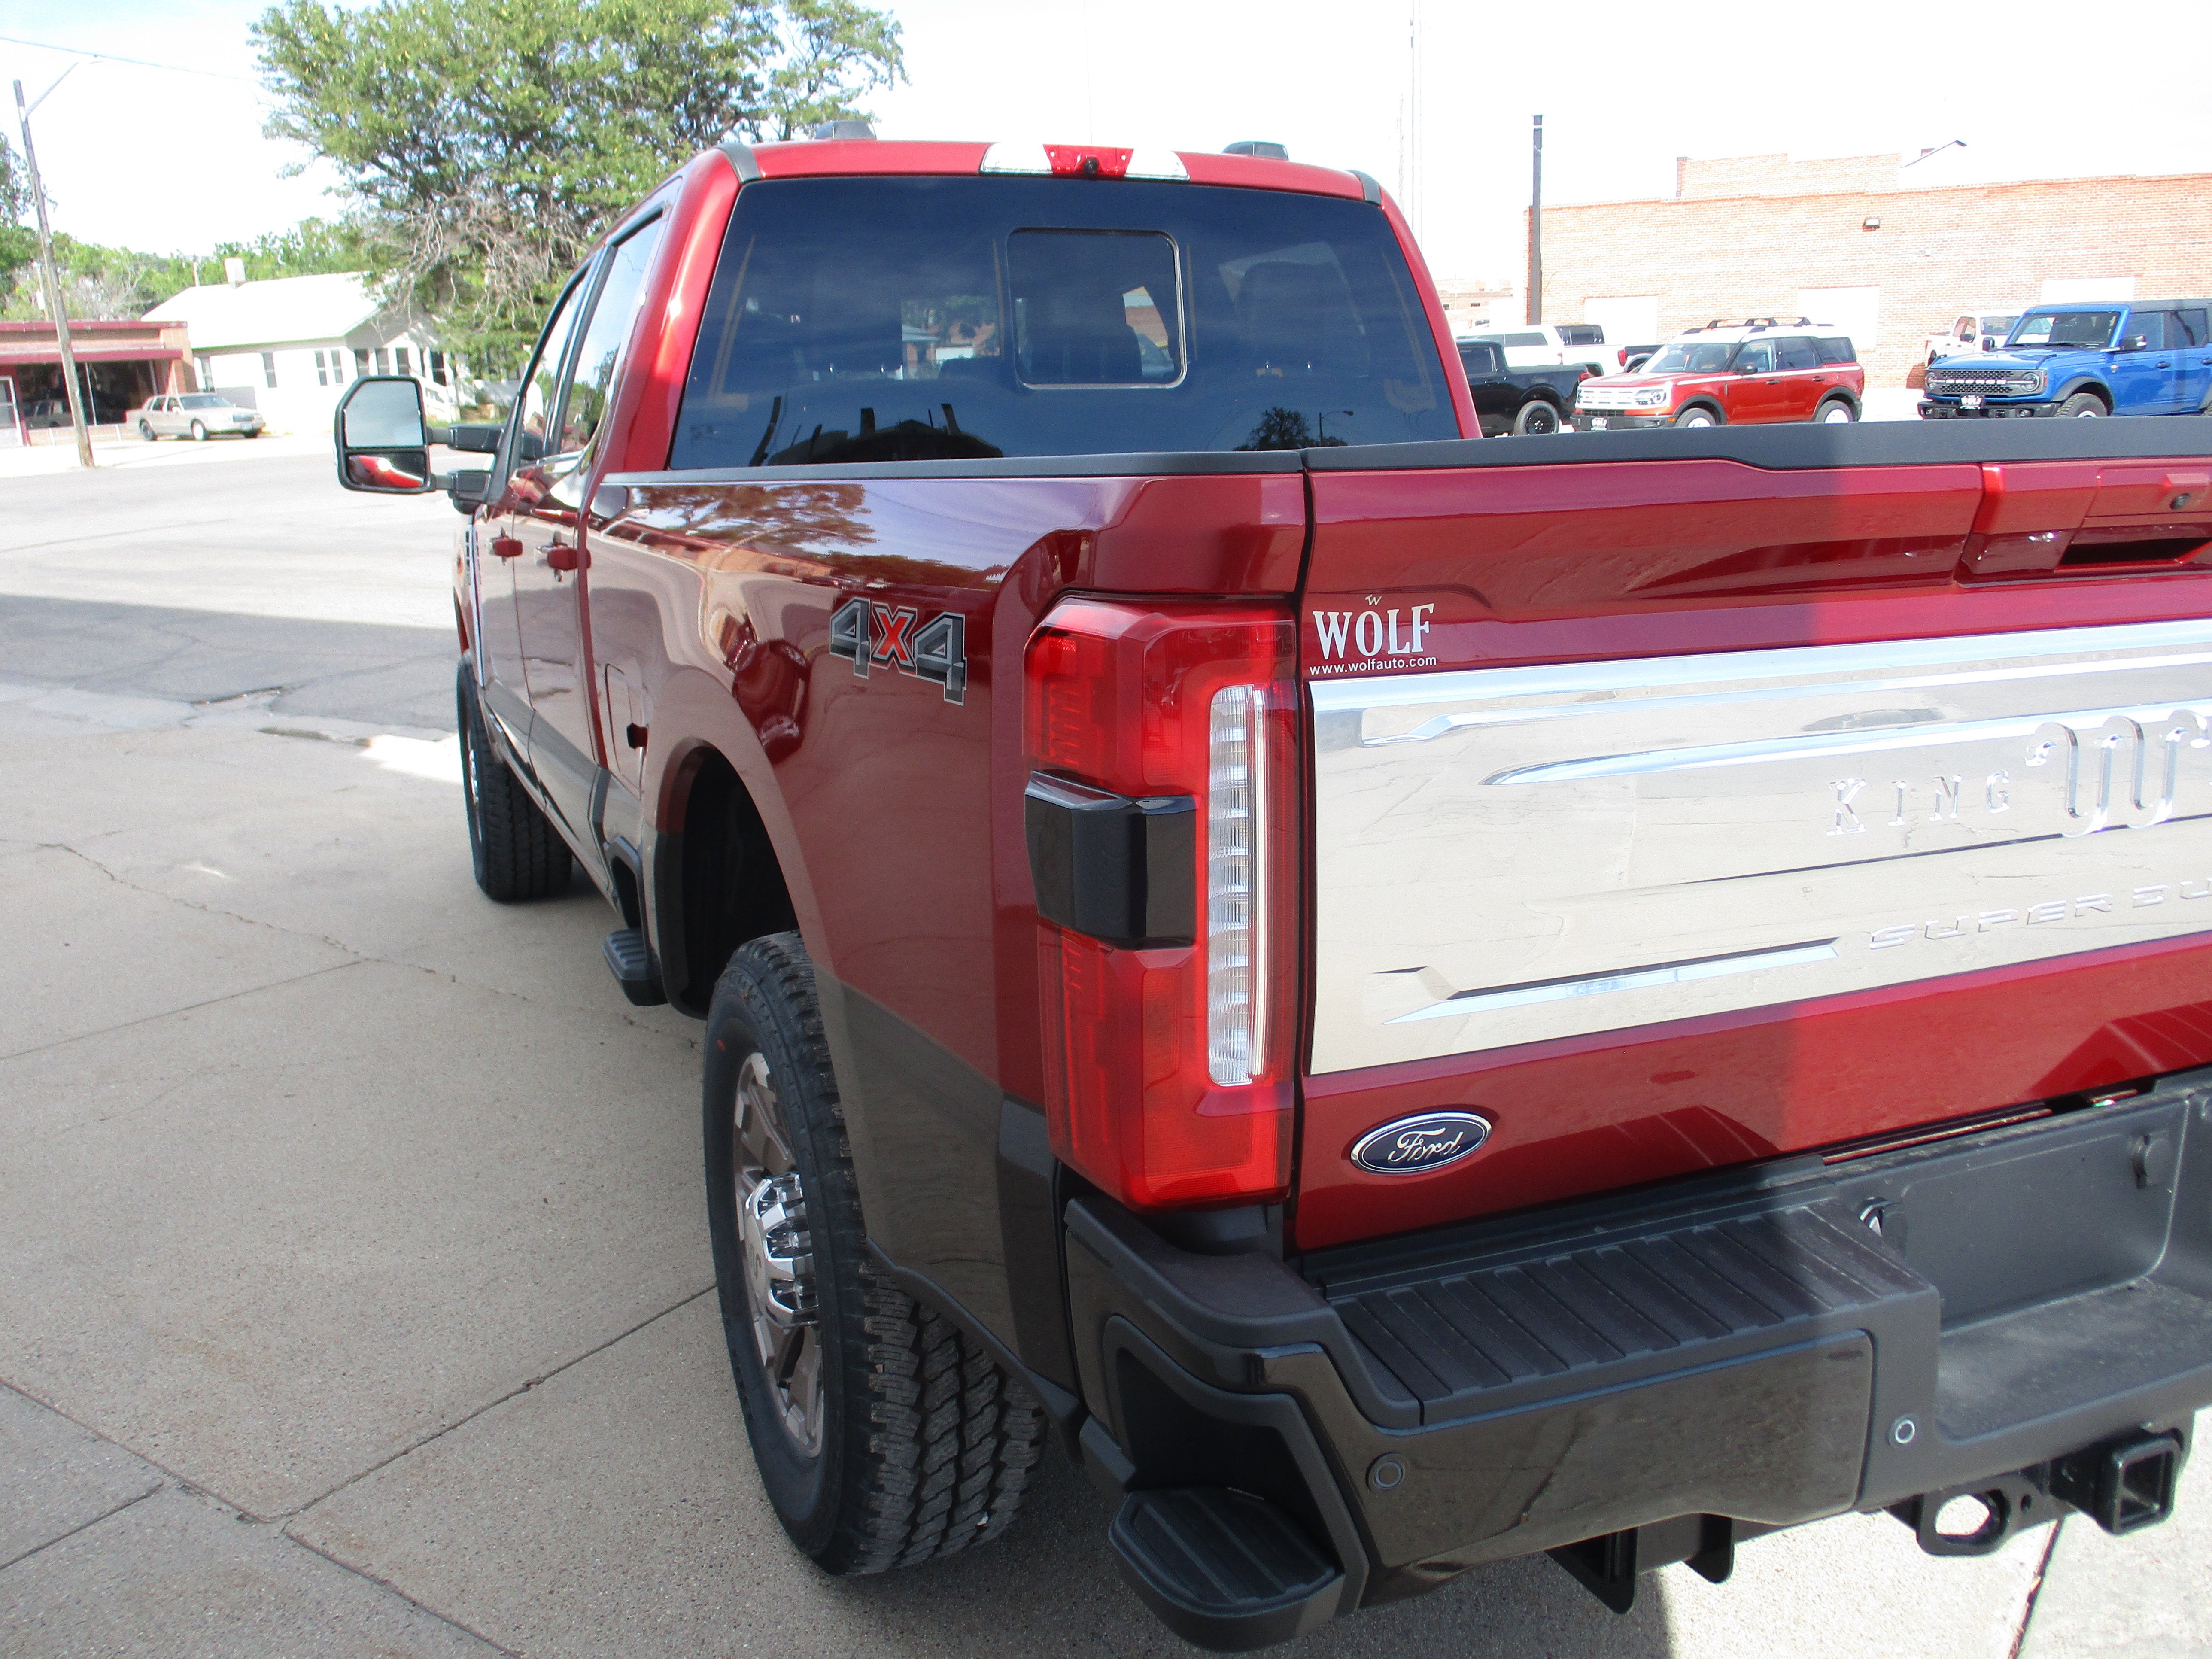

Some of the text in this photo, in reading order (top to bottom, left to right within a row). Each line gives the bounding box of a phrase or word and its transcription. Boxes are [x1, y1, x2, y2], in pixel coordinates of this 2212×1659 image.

[1312, 603, 1435, 660] WOLF
[1309, 656, 1437, 675] www.wolfauto.com
[1826, 770, 2011, 836] KING
[1870, 893, 2113, 950] SUPER
[1387, 1127, 1465, 1162] Ford
